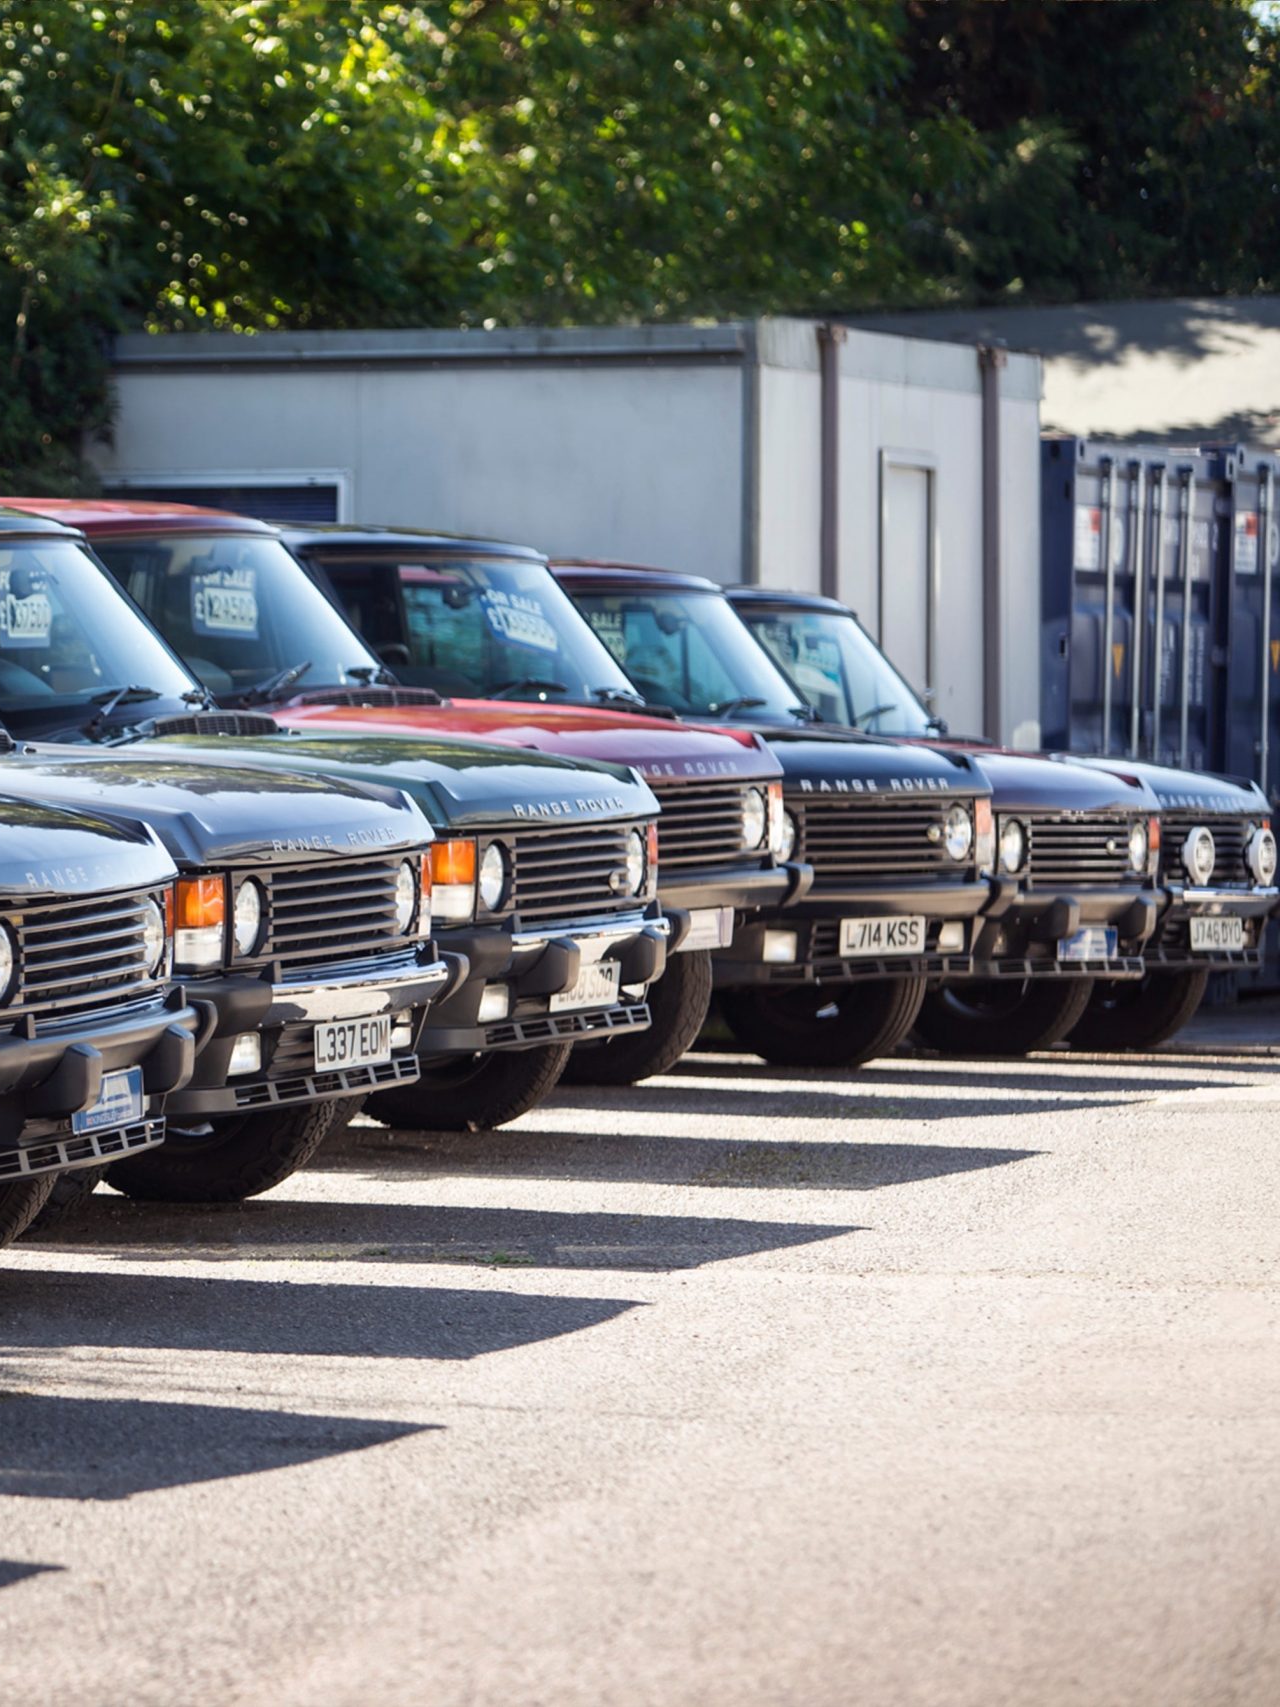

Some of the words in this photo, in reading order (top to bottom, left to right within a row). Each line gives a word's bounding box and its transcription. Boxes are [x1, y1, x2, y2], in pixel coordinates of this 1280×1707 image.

[510, 594, 542, 615] SALE
[591, 611, 622, 628] SALE
[636, 763, 675, 777] NGE
[683, 761, 738, 776] ROVER
[800, 778, 878, 793] RANGE
[889, 777, 950, 792] ROVER
[512, 801, 573, 817] RANGE
[575, 797, 625, 812] ROVER
[272, 835, 335, 853] RANGE
[346, 826, 397, 846] ROVER
[24, 865, 89, 890] RANGE
[846, 923, 882, 949] L714
[887, 921, 919, 947] KSS
[316, 1025, 356, 1064] L337
[360, 1020, 388, 1057] EOM
